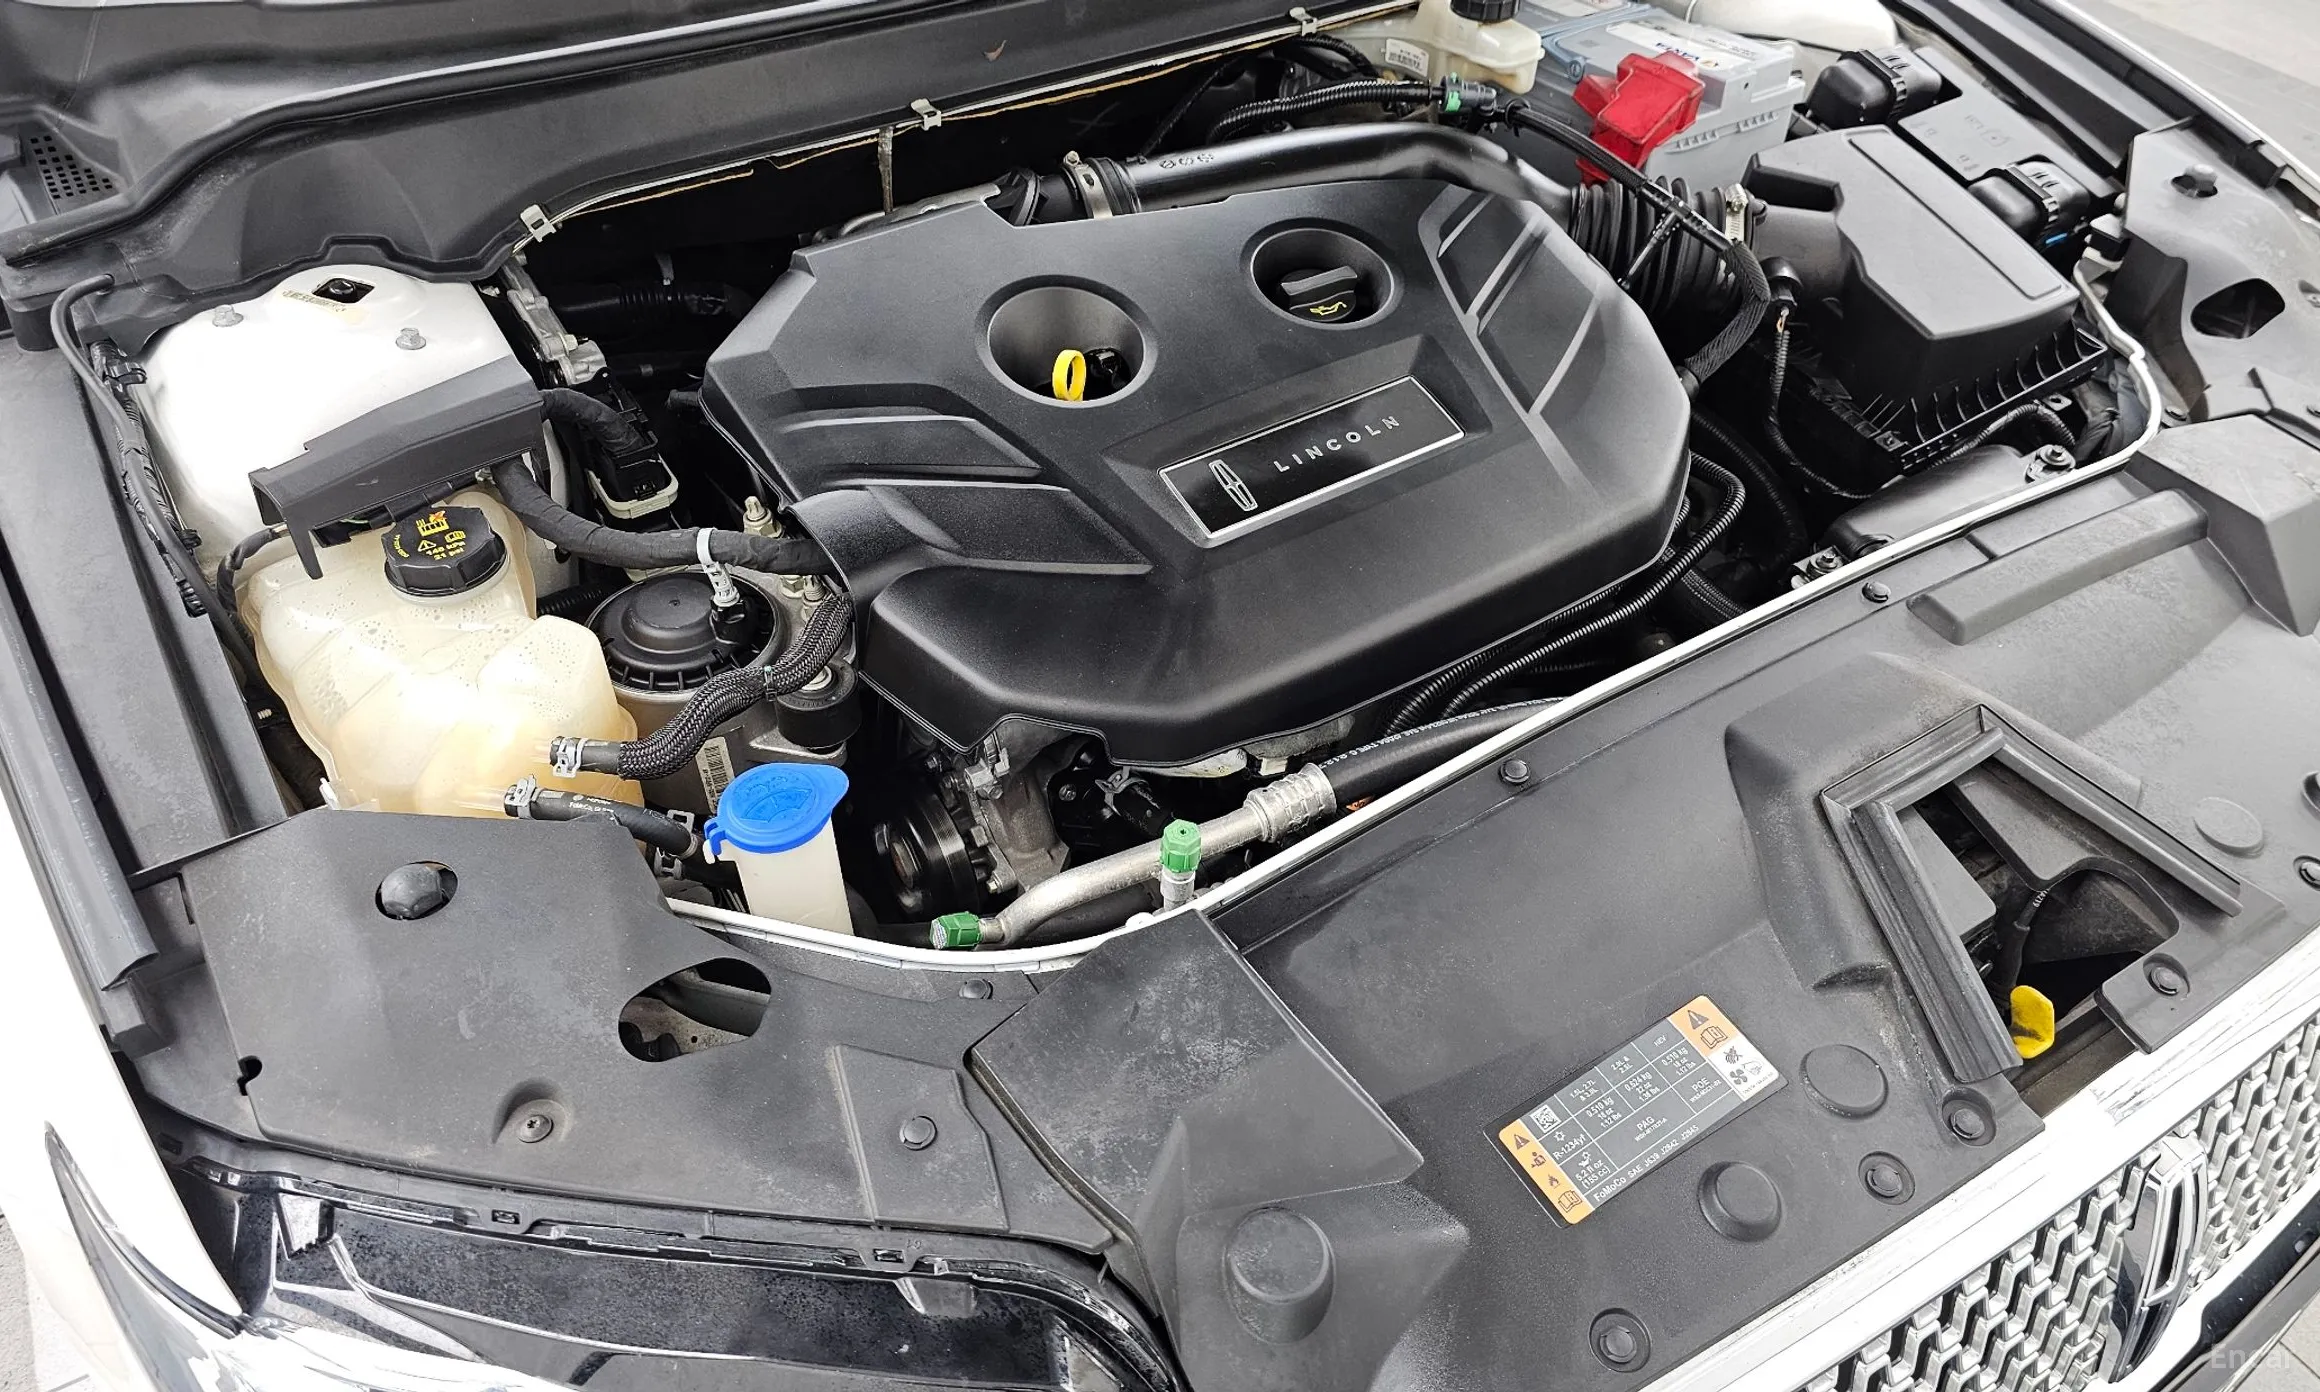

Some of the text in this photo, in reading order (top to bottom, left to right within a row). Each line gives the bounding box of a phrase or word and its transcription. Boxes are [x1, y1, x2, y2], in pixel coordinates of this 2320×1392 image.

[1273, 416, 1399, 472] LINCOLN
[1691, 1076, 1710, 1092] POE
[1636, 1115, 1655, 1130] PAG
[1552, 1133, 1588, 1161] R-1234yf
[1575, 1159, 1603, 1181] 5.2 fl oz
[1581, 1165, 1610, 1188] (155 cc)
[1593, 1175, 1627, 1201] FoMoCo
[1626, 1164, 1643, 1177] SAE
[1642, 1152, 1660, 1166] J639
[1658, 1138, 1679, 1154] J2842
